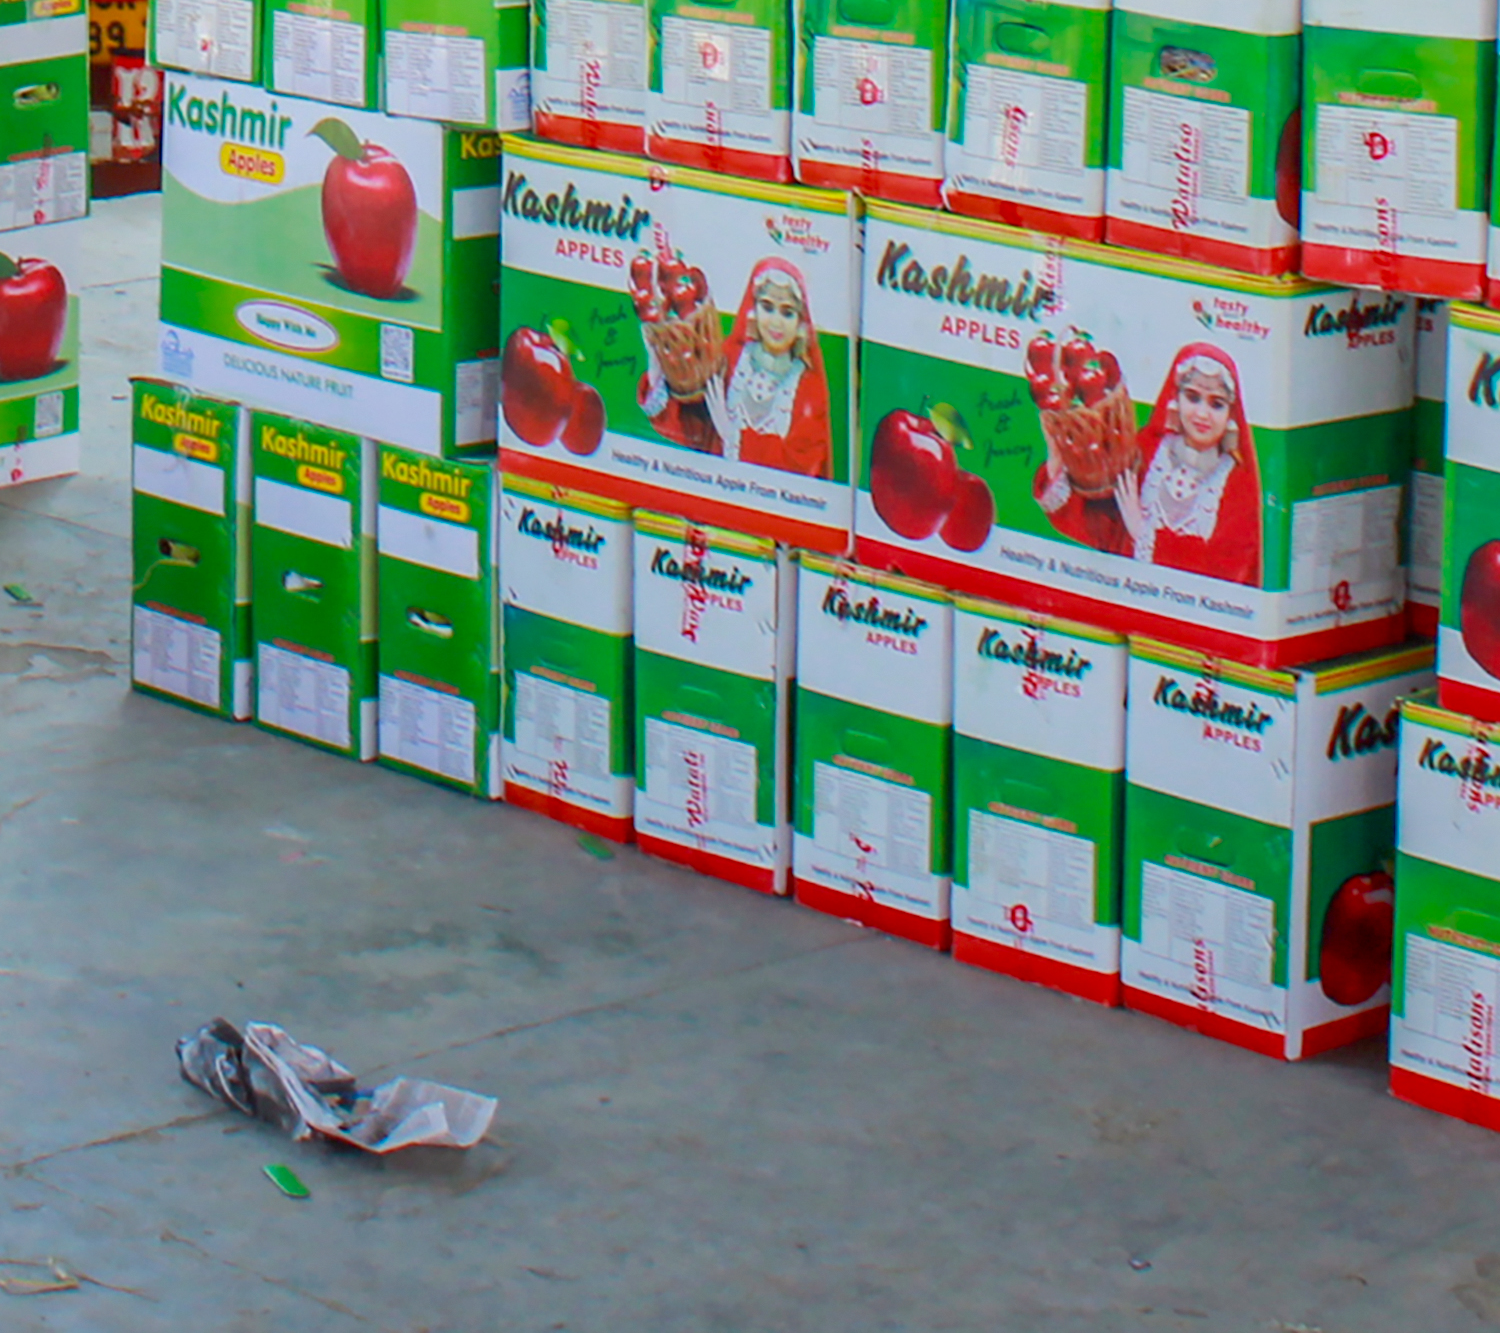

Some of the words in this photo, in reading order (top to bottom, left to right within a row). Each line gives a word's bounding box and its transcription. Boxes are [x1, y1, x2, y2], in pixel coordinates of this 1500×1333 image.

[168, 81, 291, 152] Kashmir
[226, 150, 276, 180] Apples
[501, 172, 651, 241] Kashmir
[555, 238, 625, 268] APPLES
[877, 239, 1054, 324] Kashmir
[1212, 296, 1249, 317] tasty
[1214, 313, 1271, 338] healthy
[940, 314, 1021, 350] APPLES
[223, 352, 278, 378] DELICIOUS
[281, 369, 322, 391] NATURE
[325, 379, 353, 398] FRUIT
[140, 395, 222, 440] Kashmir
[261, 426, 346, 470] Kashmir
[300, 464, 340, 491] Apples
[382, 452, 471, 499] Kashmir
[611, 449, 649, 472] Healthy
[652, 459, 661, 471] &
[663, 463, 713, 485] Nutritious
[716, 474, 748, 493] Apple
[750, 481, 777, 500] From
[780, 487, 827, 510] Kashmir
[424, 491, 468, 519] Apples
[999, 544, 1045, 570] Healthy
[1049, 558, 1058, 573] &
[1060, 561, 1121, 590] Nutritious
[1122, 575, 1160, 600] Apple
[1163, 584, 1197, 606] From
[1199, 593, 1255, 619] Kashmir
[866, 631, 919, 657] APPLES
[1203, 724, 1264, 753] APPLES
